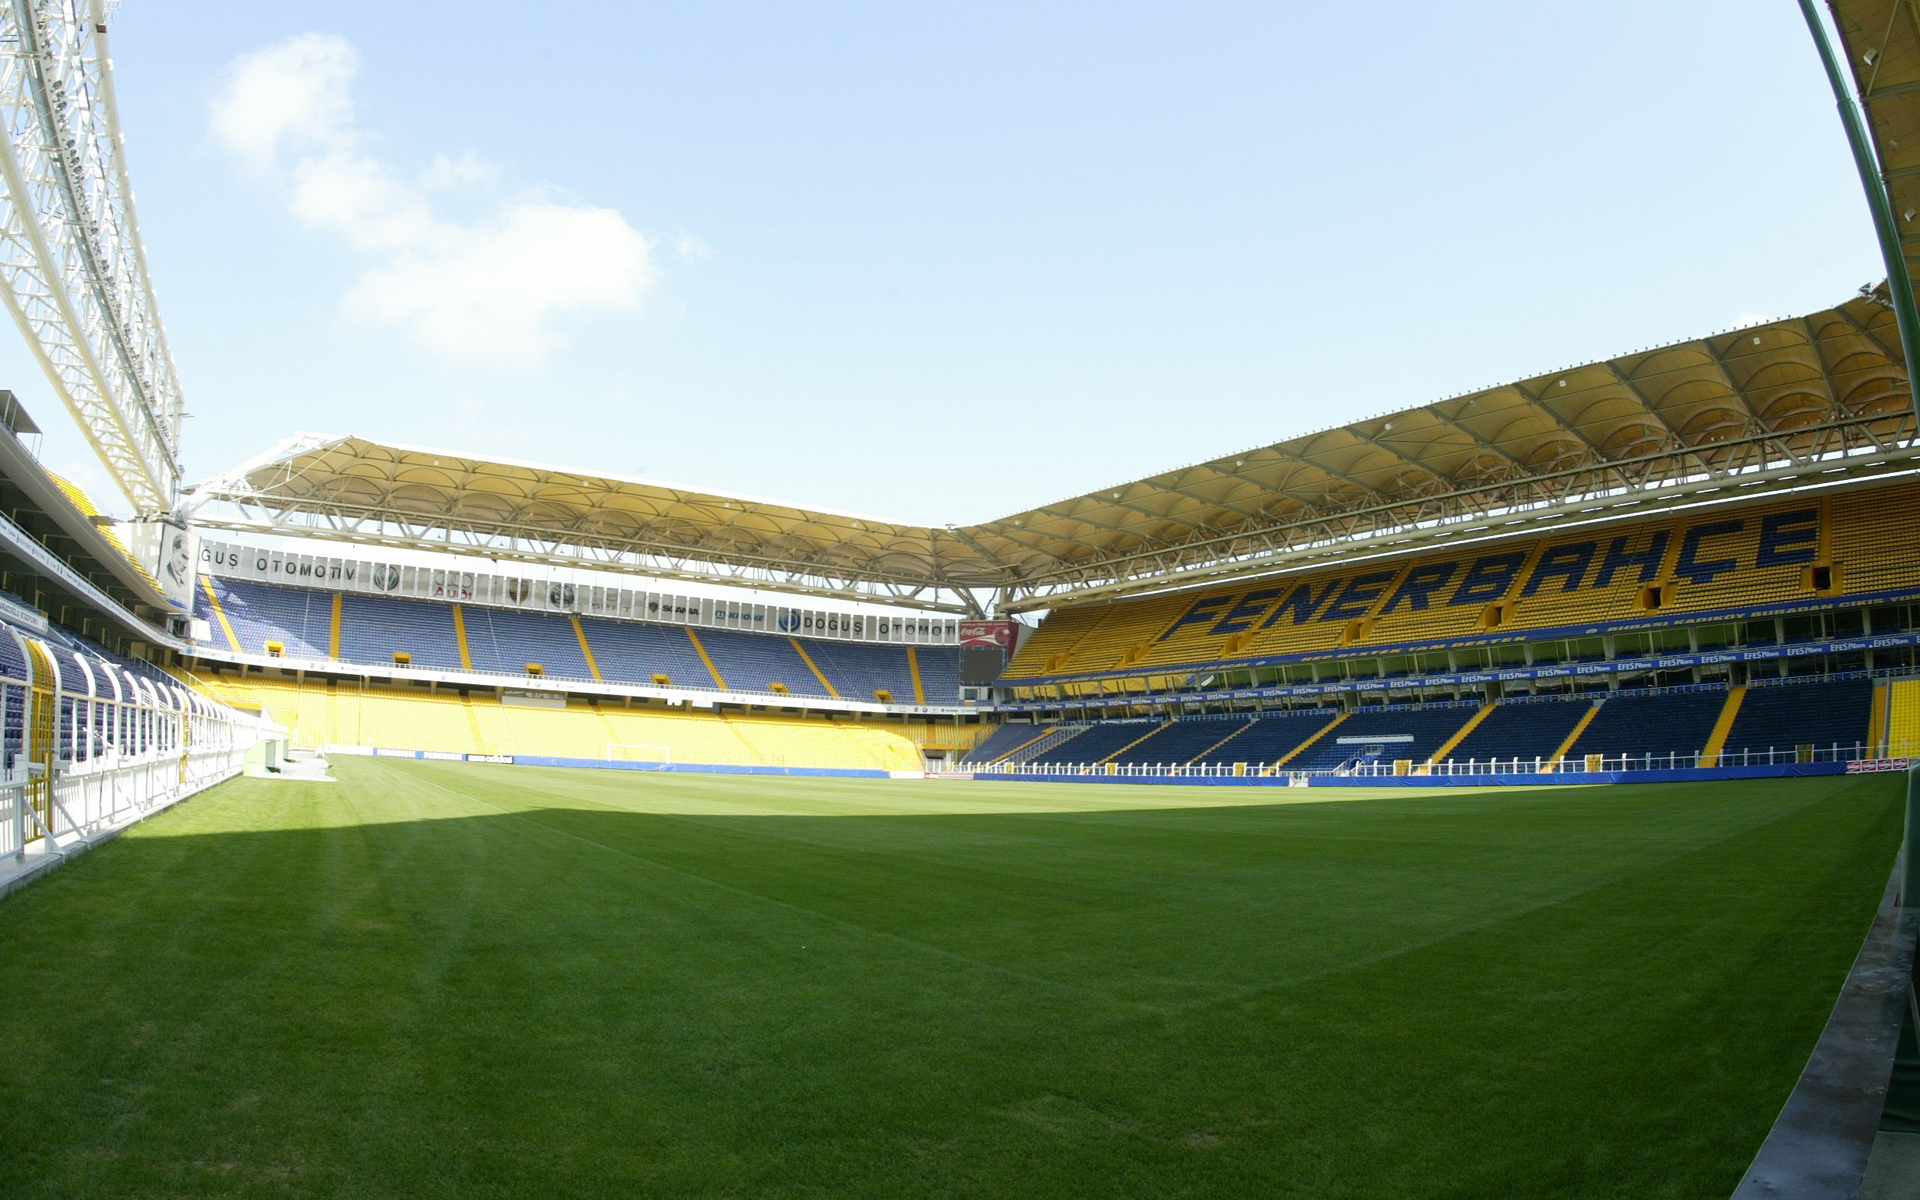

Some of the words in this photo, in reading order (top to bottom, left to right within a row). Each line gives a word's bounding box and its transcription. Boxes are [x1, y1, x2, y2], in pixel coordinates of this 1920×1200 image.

[256, 558, 355, 580] OTOMOTİV
[1158, 508, 1819, 641] FENERBAHÇE
[662, 605, 699, 616] SCANIA
[1607, 621, 1670, 632] BURASI
[1751, 603, 1834, 618] BURADAN
[804, 615, 863, 636] DOĞUŞ
[1337, 648, 1402, 659] DESTEK
[1408, 643, 1447, 652] TAM
[1451, 635, 1528, 648] DESTEK
[1830, 643, 1847, 652] EFES
[1874, 639, 1890, 648] EFES
[1744, 651, 1761, 660] EFES
[1787, 647, 1804, 656] EFES
[1659, 659, 1676, 667] EFES
[1702, 655, 1718, 664] EFES
[1577, 666, 1593, 674] EFES
[1618, 662, 1634, 671] EFES
[1538, 669, 1553, 677] EFES
